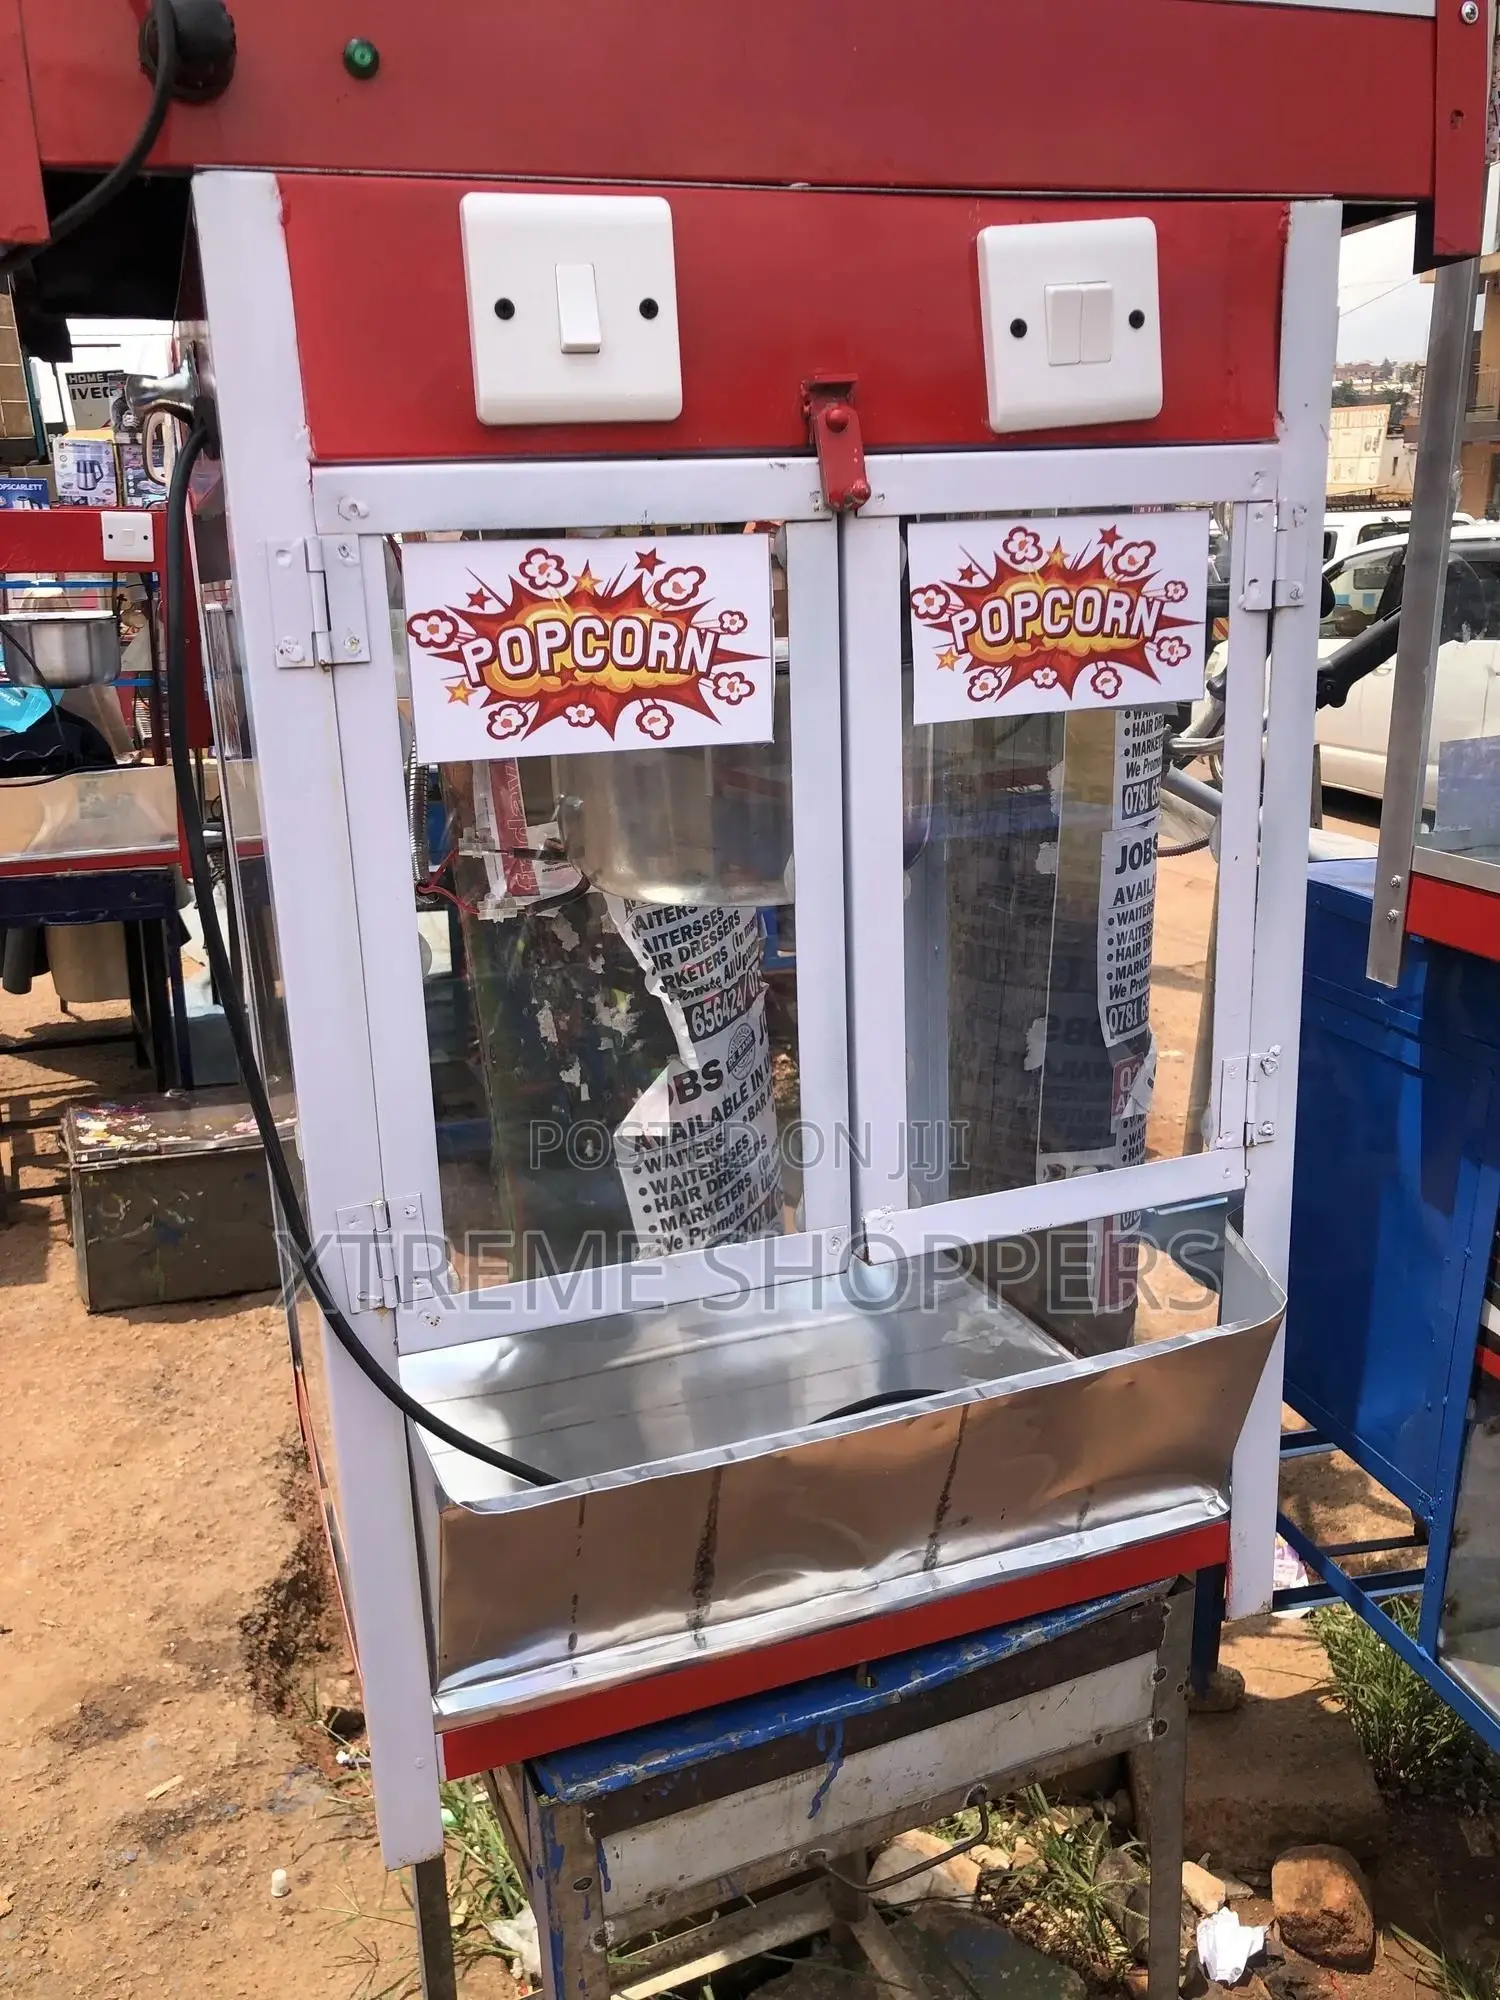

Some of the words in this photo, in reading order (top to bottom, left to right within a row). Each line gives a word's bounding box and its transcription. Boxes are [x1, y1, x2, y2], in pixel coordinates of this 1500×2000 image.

[68, 373, 105, 384] HOME
[949, 586, 1166, 655] POPCORN
[459, 614, 720, 688] POPCORN
[1125, 760, 1140, 779] We
[1109, 981, 1127, 1001] We
[643, 1132, 723, 1174] WAITERS
[653, 1185, 702, 1214] HAIR
[659, 1172, 752, 1234] MARKETERS
[688, 1201, 745, 1246] Promote
